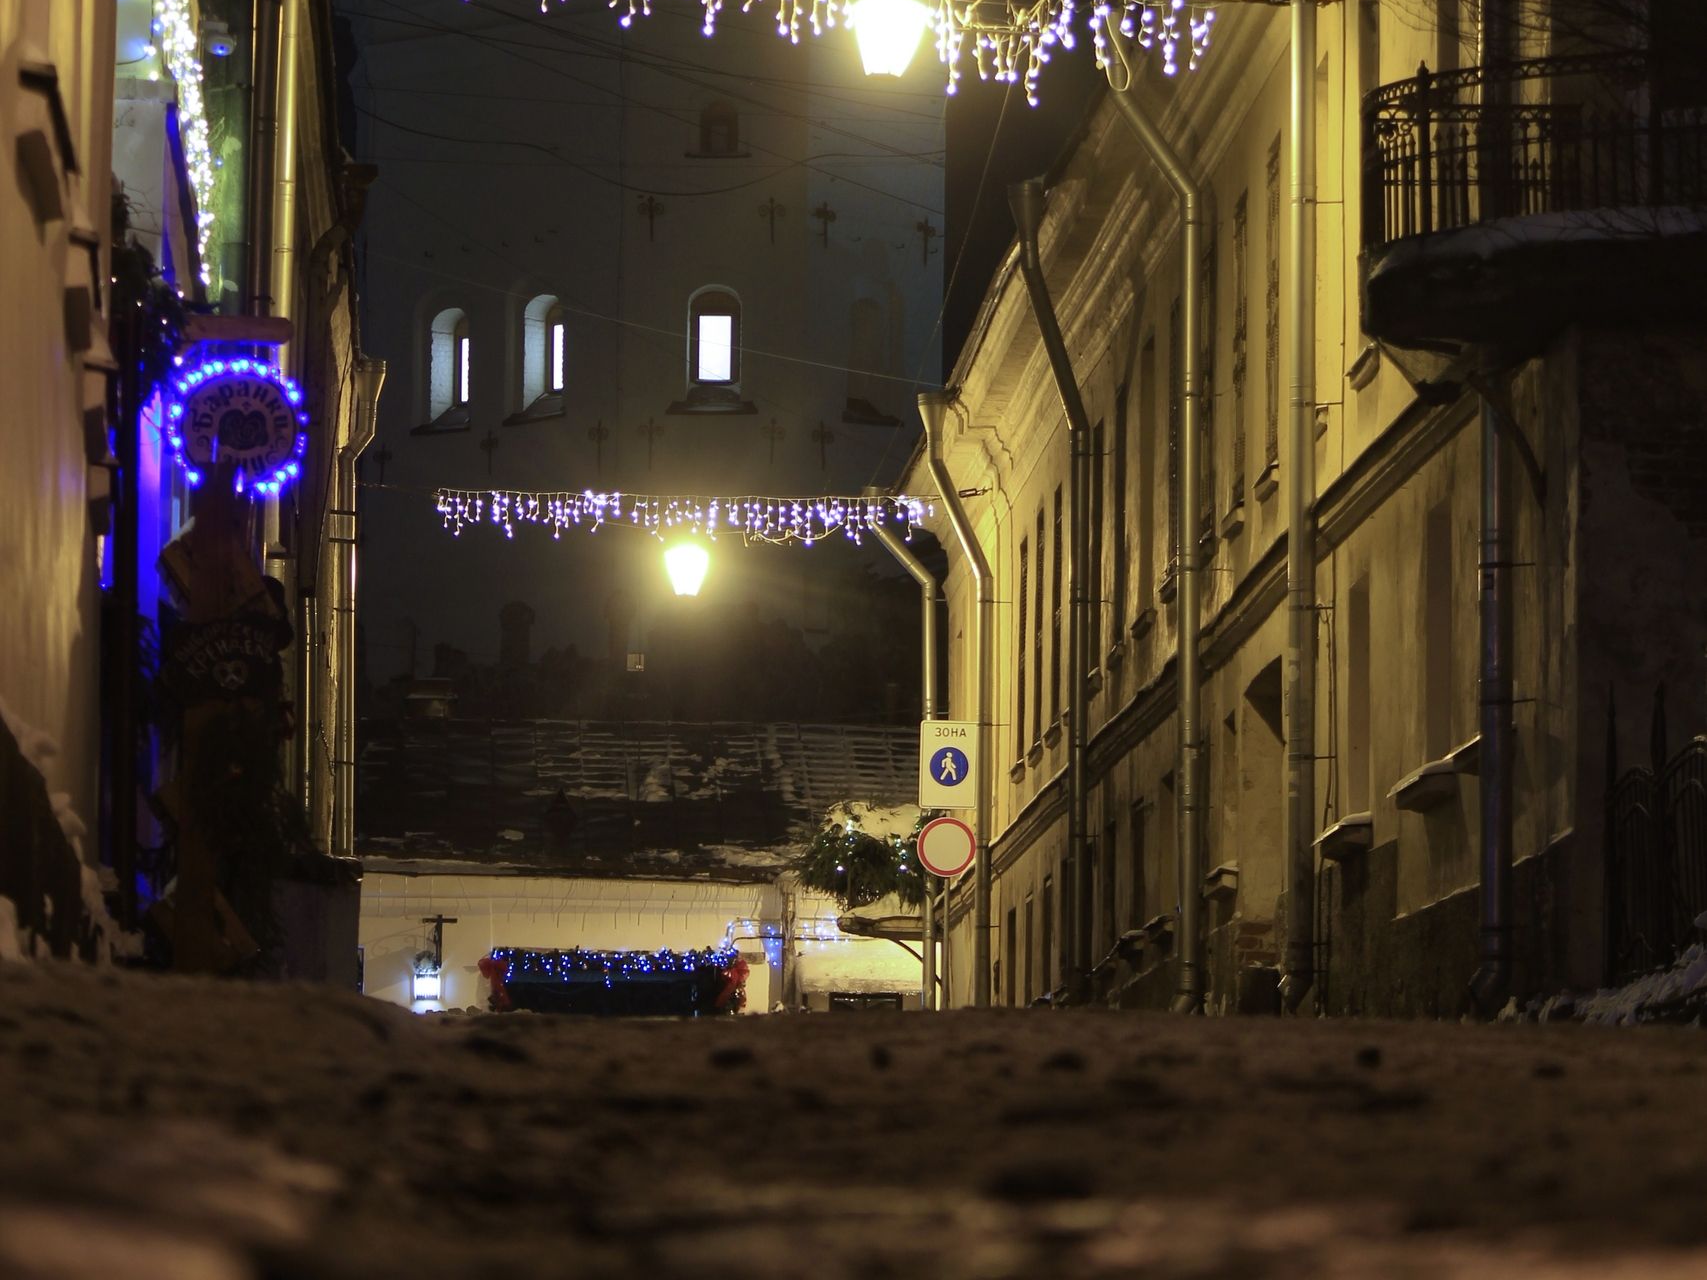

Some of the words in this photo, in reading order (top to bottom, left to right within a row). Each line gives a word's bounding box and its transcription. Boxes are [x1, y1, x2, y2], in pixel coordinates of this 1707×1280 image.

[190, 380, 289, 432] Баранки
[185, 639, 273, 679] КРЕНДЕЛЬ
[935, 727, 966, 737] ЗОНА
